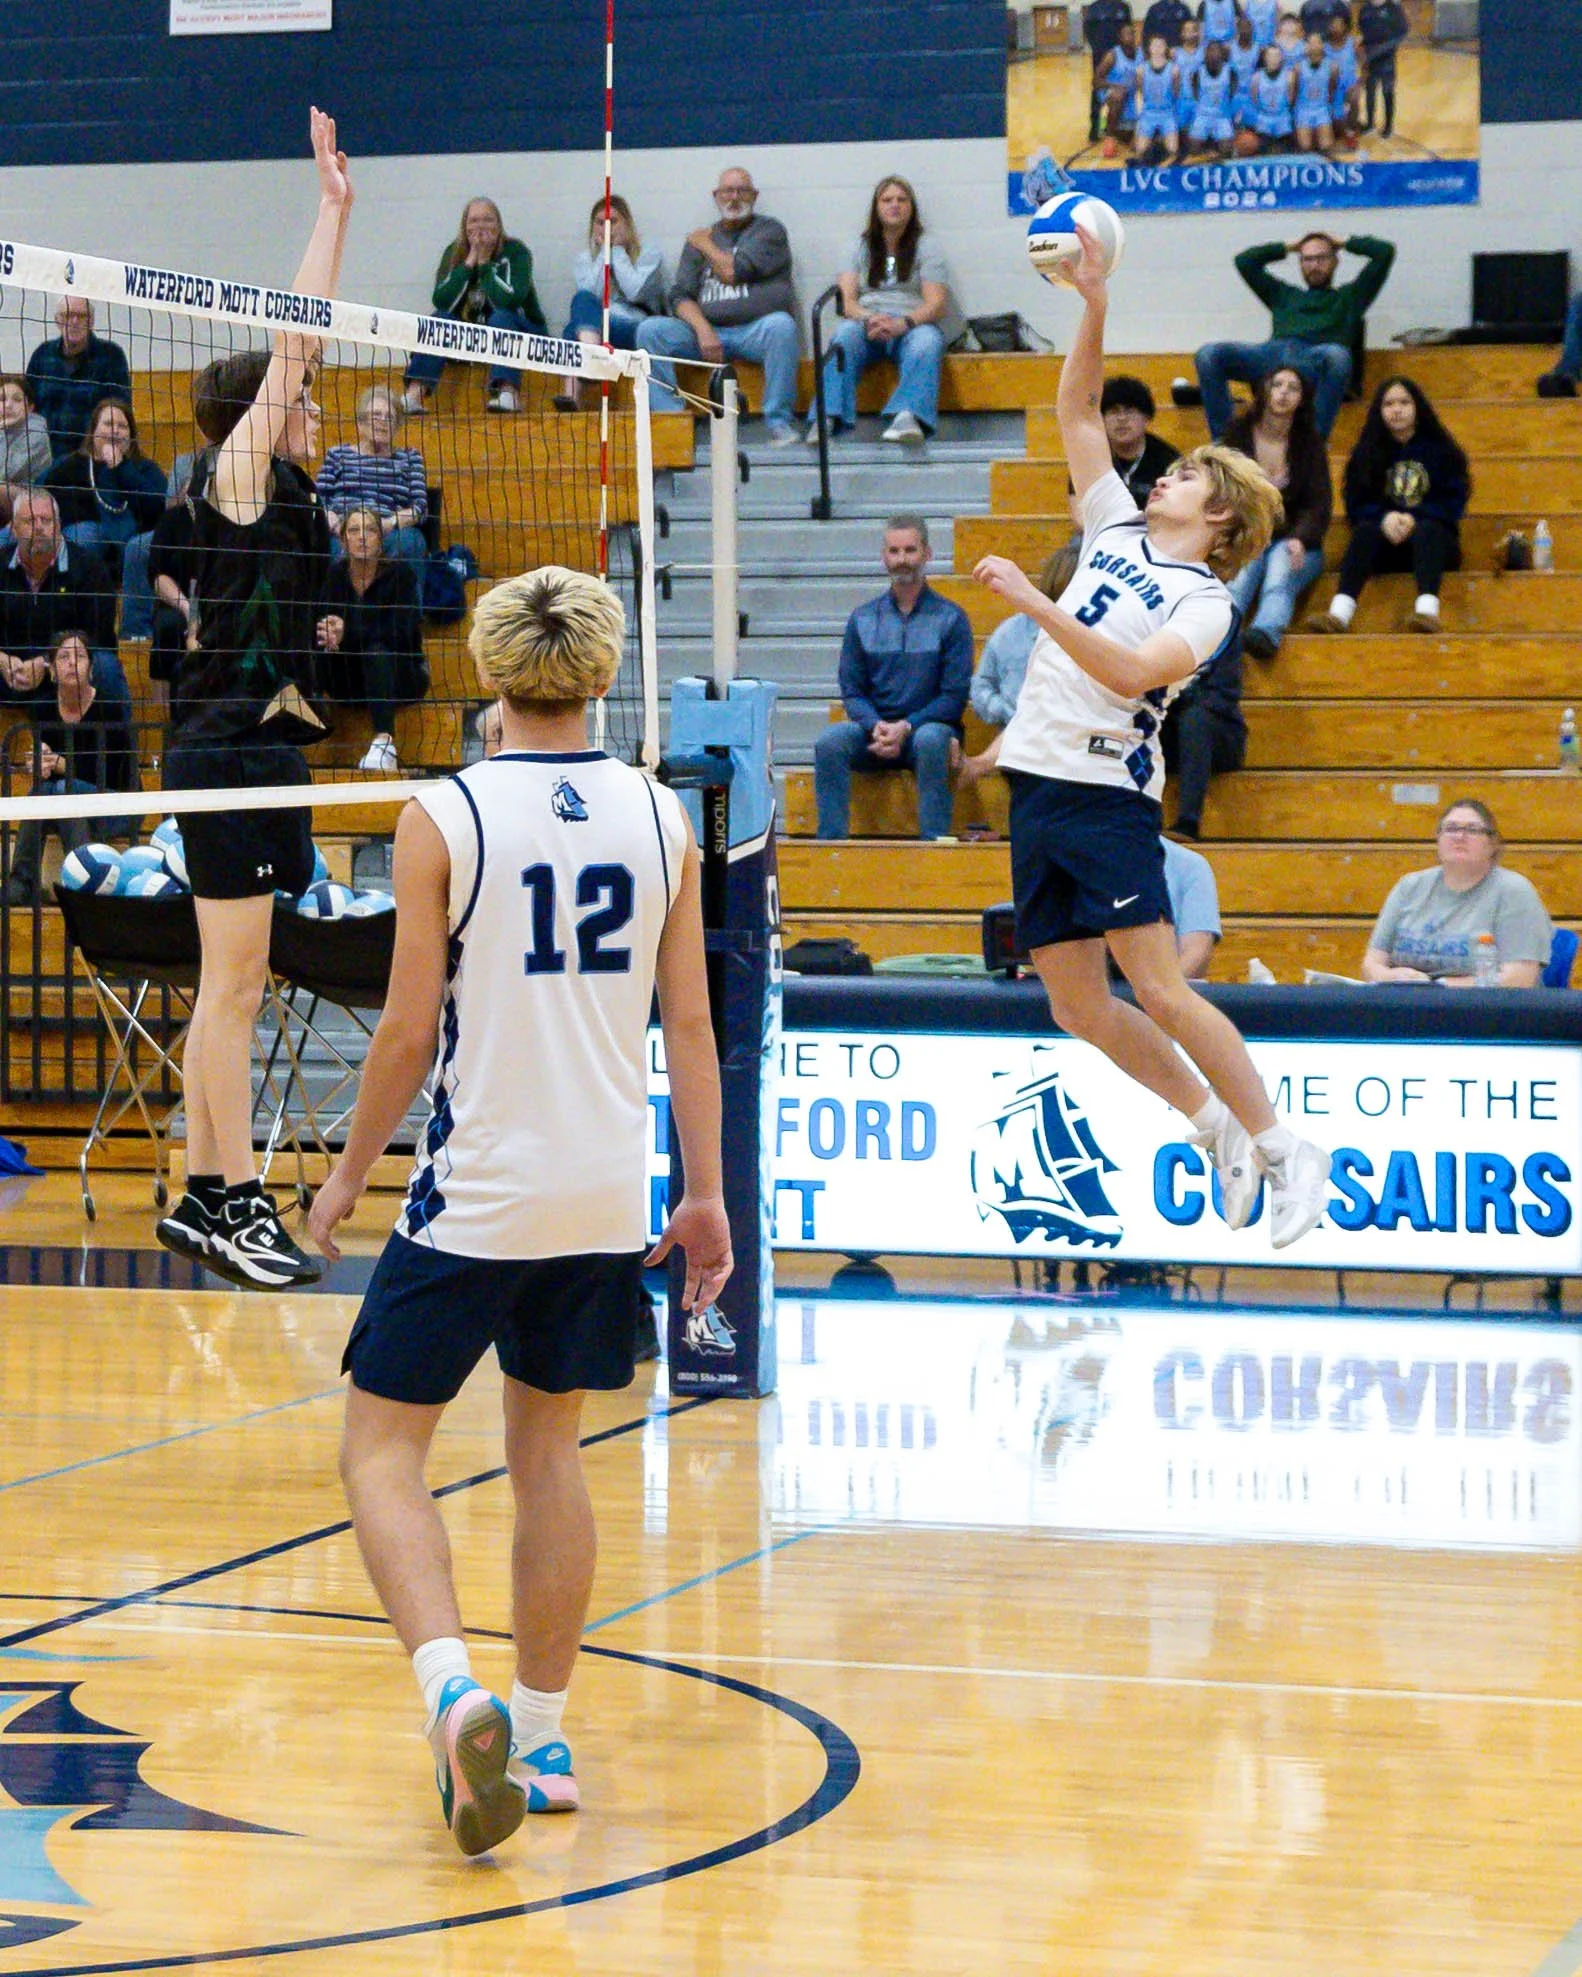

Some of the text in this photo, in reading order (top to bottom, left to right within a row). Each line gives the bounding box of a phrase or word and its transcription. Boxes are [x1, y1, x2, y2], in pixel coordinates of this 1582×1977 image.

[1120, 162, 1365, 193] LVC CHAMPIONS
[1203, 190, 1278, 209] 2024
[124, 265, 333, 328] WATERFORD MOTT CORSAIRS
[417, 317, 583, 368] WATERFORD MOTT CORSAIRS
[1075, 583, 1121, 628] 5
[520, 862, 635, 976] 12
[839, 1042, 901, 1080] TO
[1355, 1076, 1427, 1117] OF
[1448, 1079, 1559, 1121] THE
[1153, 1141, 1573, 1239] CSAIRS
